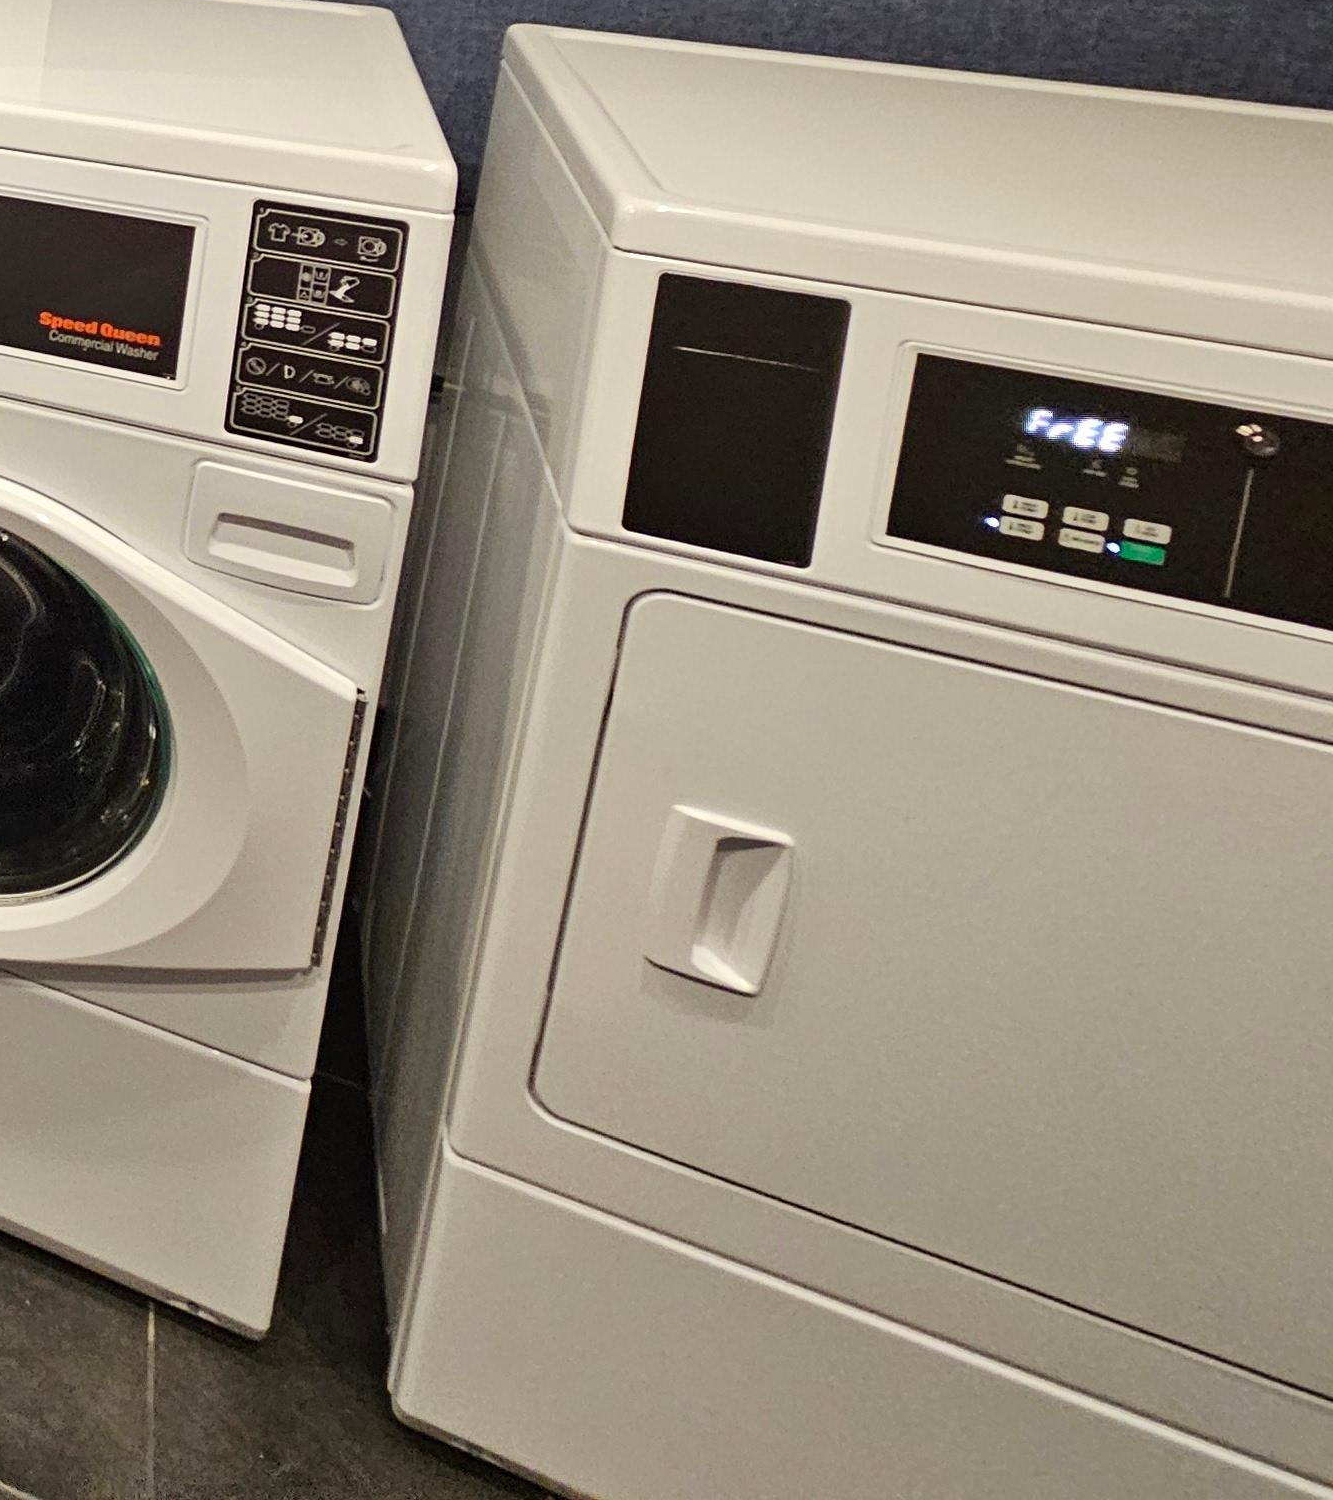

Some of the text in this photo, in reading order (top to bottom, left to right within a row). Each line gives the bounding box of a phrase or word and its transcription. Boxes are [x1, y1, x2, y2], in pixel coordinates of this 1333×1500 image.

[39, 311, 161, 347] Speed Queen
[48, 329, 159, 361] Commercial Washer
